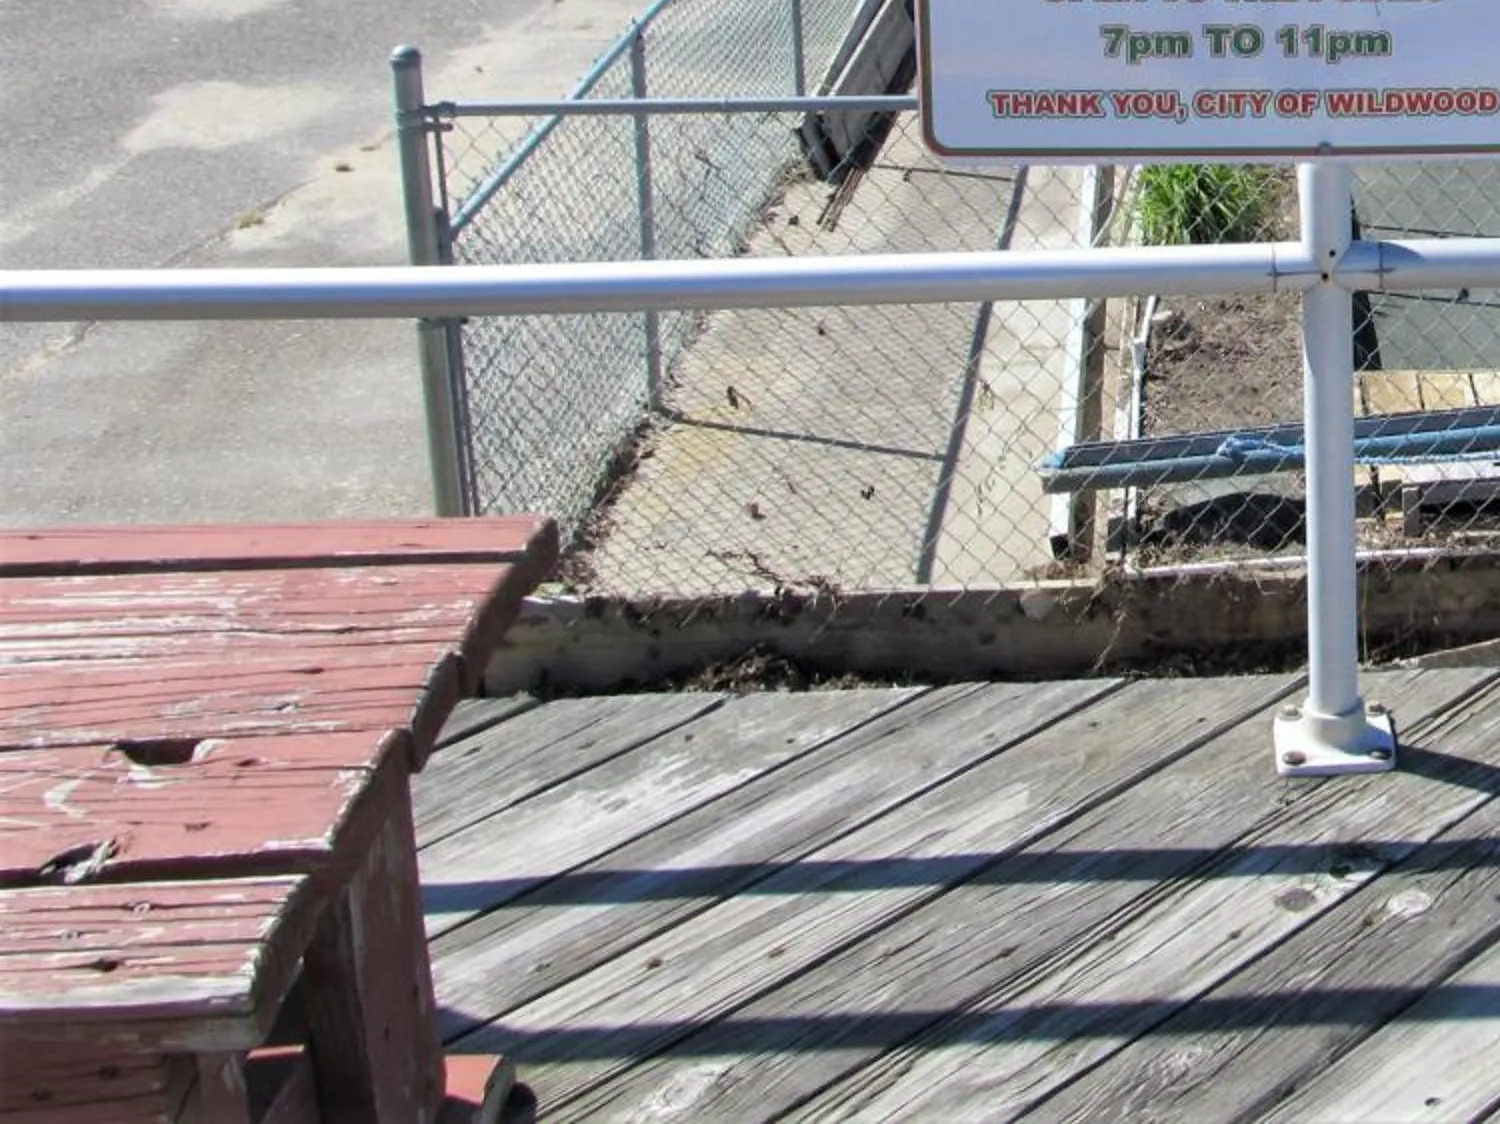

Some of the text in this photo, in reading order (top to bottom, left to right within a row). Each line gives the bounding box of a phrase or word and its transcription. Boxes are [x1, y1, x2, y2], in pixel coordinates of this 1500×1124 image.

[1100, 24, 1393, 65] 7pm TO 11pm
[988, 87, 1500, 123] THANK YOU, CITY OF WILDWOOD
